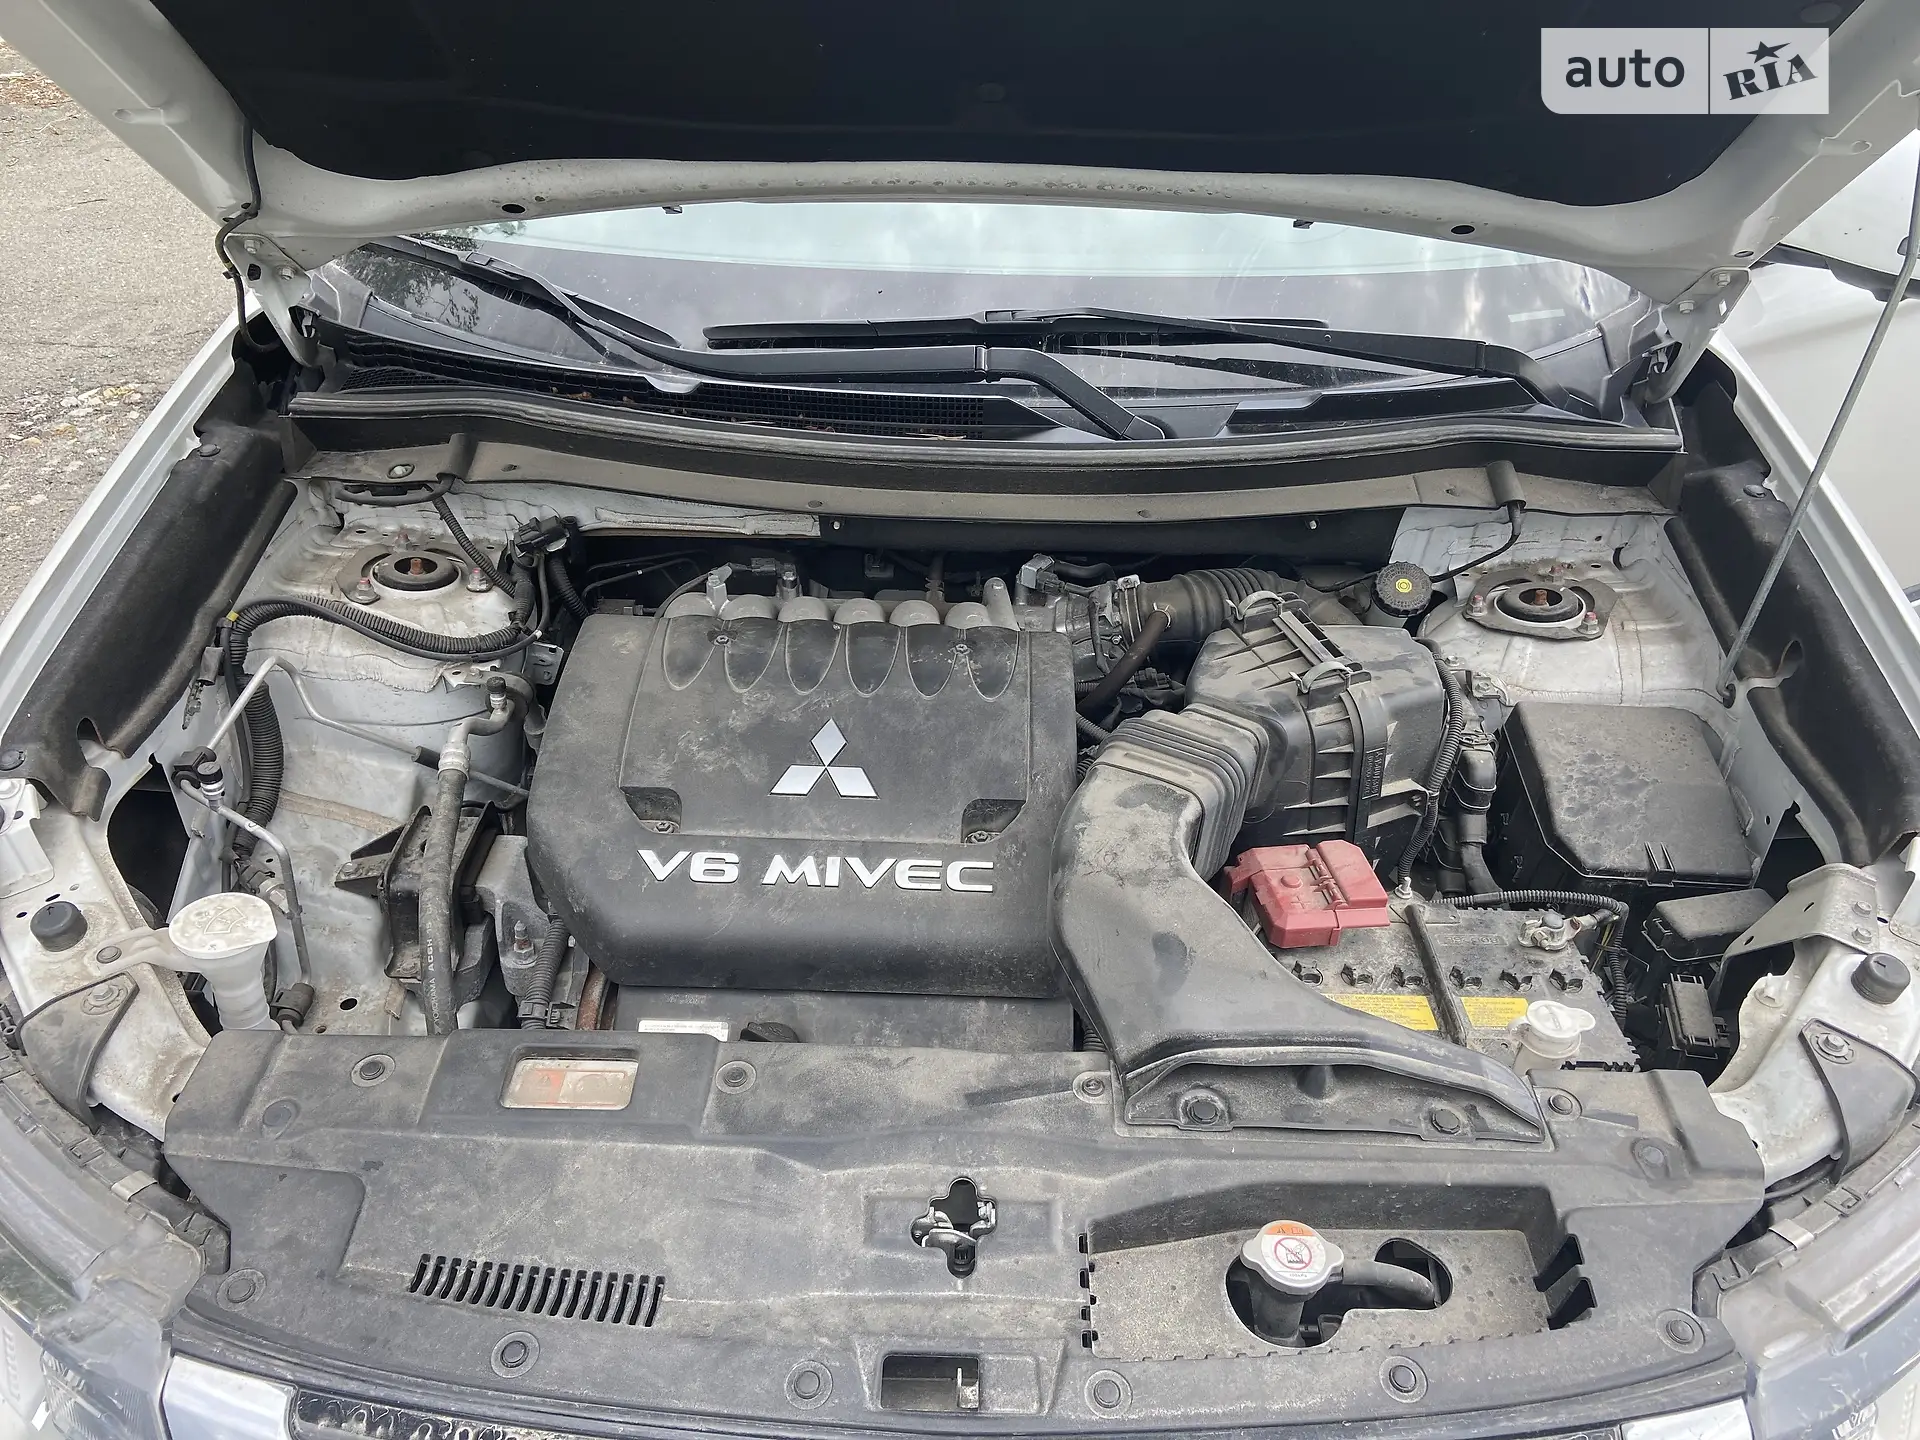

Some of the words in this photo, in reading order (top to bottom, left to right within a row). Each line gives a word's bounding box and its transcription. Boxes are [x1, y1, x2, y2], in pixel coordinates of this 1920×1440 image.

[636, 849, 740, 883] V6
[761, 854, 994, 894] MIVEC
[429, 977, 440, 1026] YOKOHAMA
